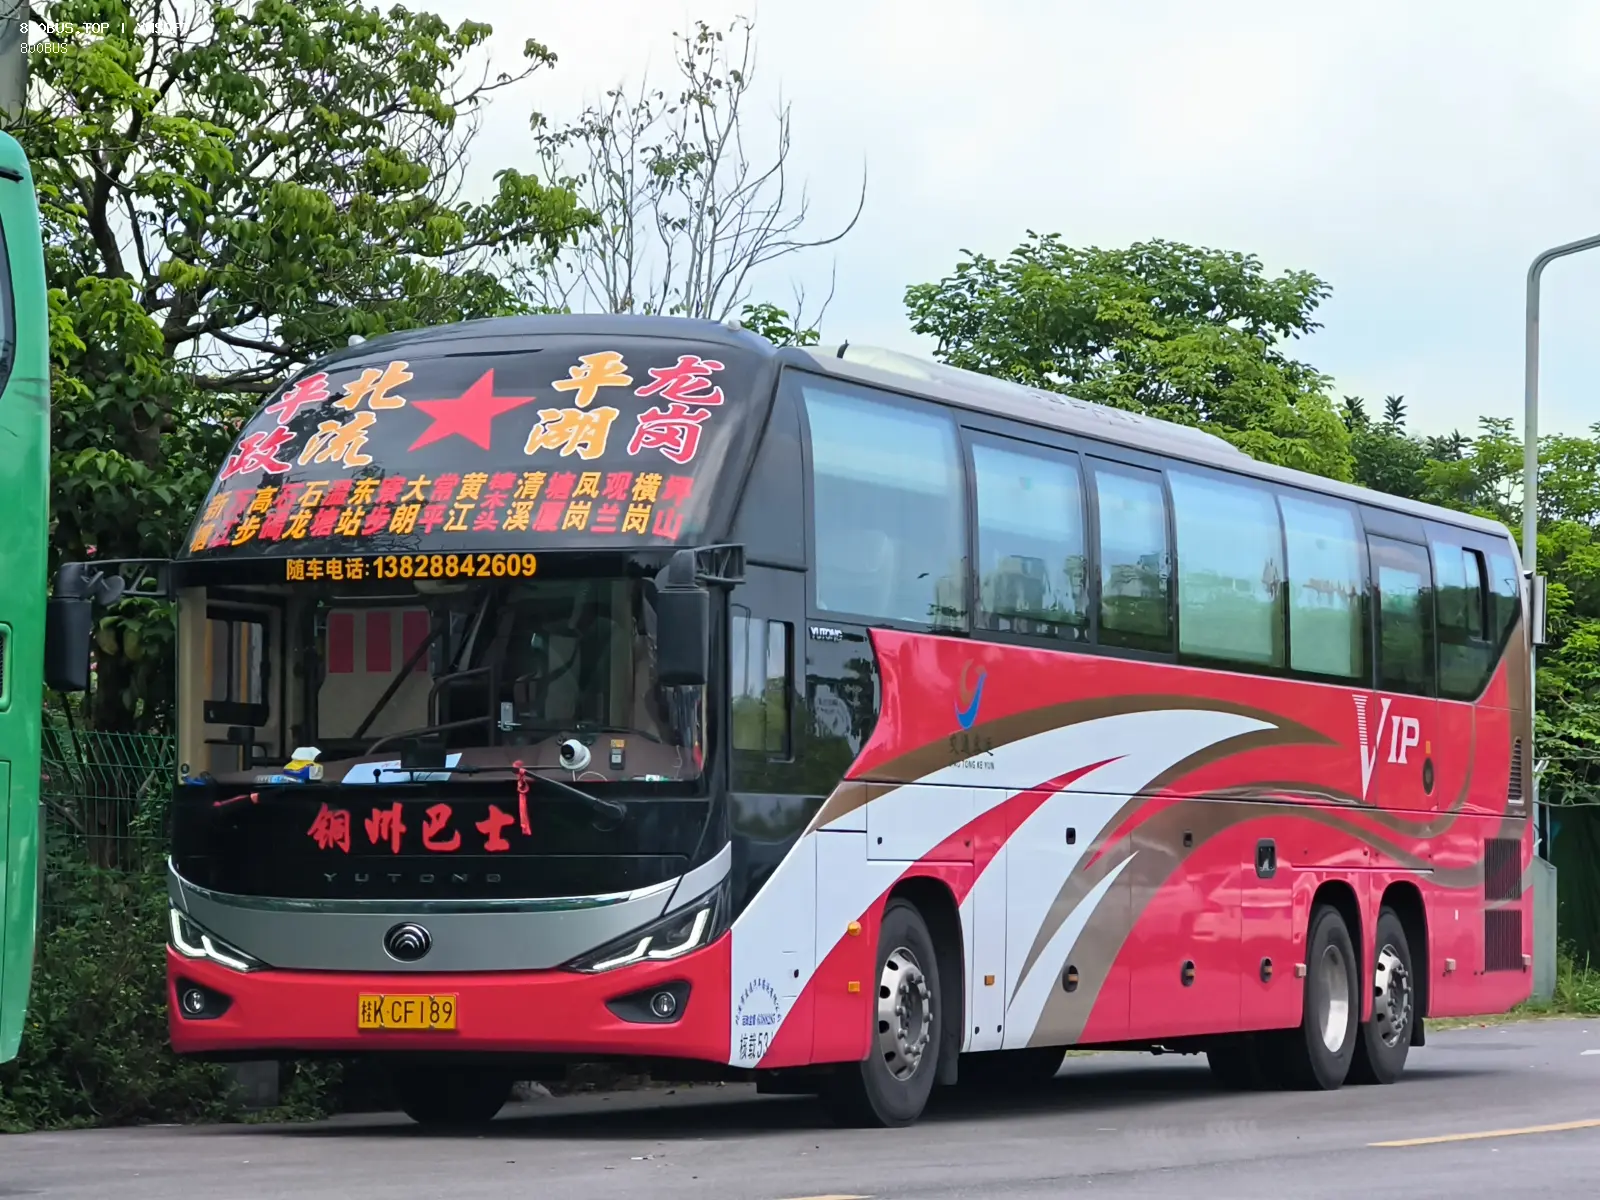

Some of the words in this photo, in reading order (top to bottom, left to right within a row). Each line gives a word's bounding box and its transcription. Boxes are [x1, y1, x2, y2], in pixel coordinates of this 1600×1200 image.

[298, 361, 413, 469] 北流
[524, 350, 633, 459] 平湖
[627, 355, 725, 463] 龙岗
[231, 485, 278, 546] 高步
[282, 480, 330, 539] 石龙
[333, 477, 380, 536] 东站
[389, 474, 432, 534] 大朗
[443, 471, 489, 532] 黄江
[502, 471, 547, 532] 清溪
[561, 471, 602, 531] 凤岗
[621, 472, 662, 534] 横岗
[810, 626, 843, 641] YUTONG
[1352, 694, 1420, 801] VIP
[323, 872, 501, 883] YUTONG
[739, 1030, 774, 1060] 核载53
